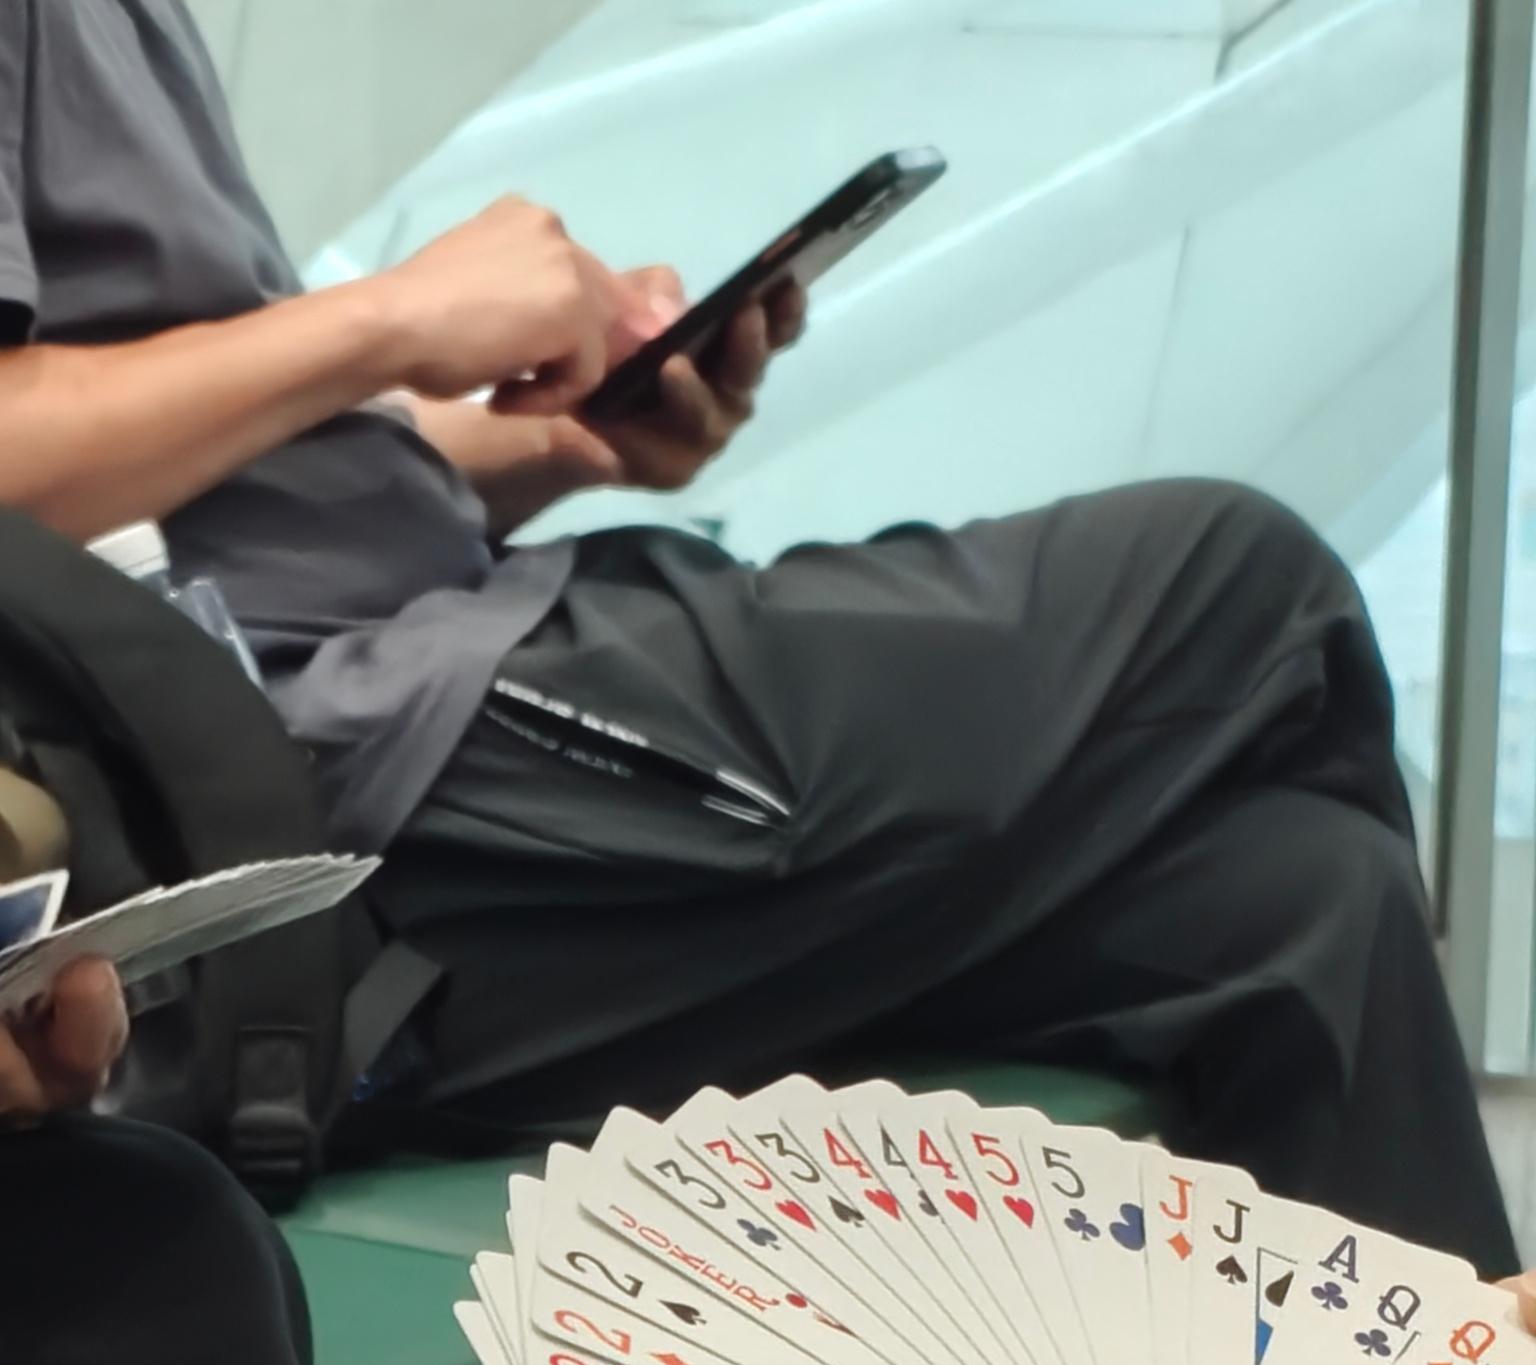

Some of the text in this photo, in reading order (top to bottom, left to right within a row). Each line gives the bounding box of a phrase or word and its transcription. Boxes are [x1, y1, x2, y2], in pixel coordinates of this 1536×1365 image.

[704, 1140, 772, 1190] 3
[754, 1133, 820, 1183] 3
[823, 1128, 872, 1179] 4
[919, 1130, 958, 1180] 4
[971, 1132, 1019, 1186] 5
[1042, 1146, 1085, 1199] 5
[654, 1159, 726, 1209] 3
[1159, 1174, 1193, 1221] J
[1213, 1200, 1250, 1243] J
[566, 1251, 643, 1298] 2
[609, 1204, 780, 1312] JOKER
[1318, 1234, 1360, 1283] A
[554, 1310, 631, 1355] 2
[1377, 1285, 1421, 1331] Q
[1449, 1321, 1496, 1364] Q
